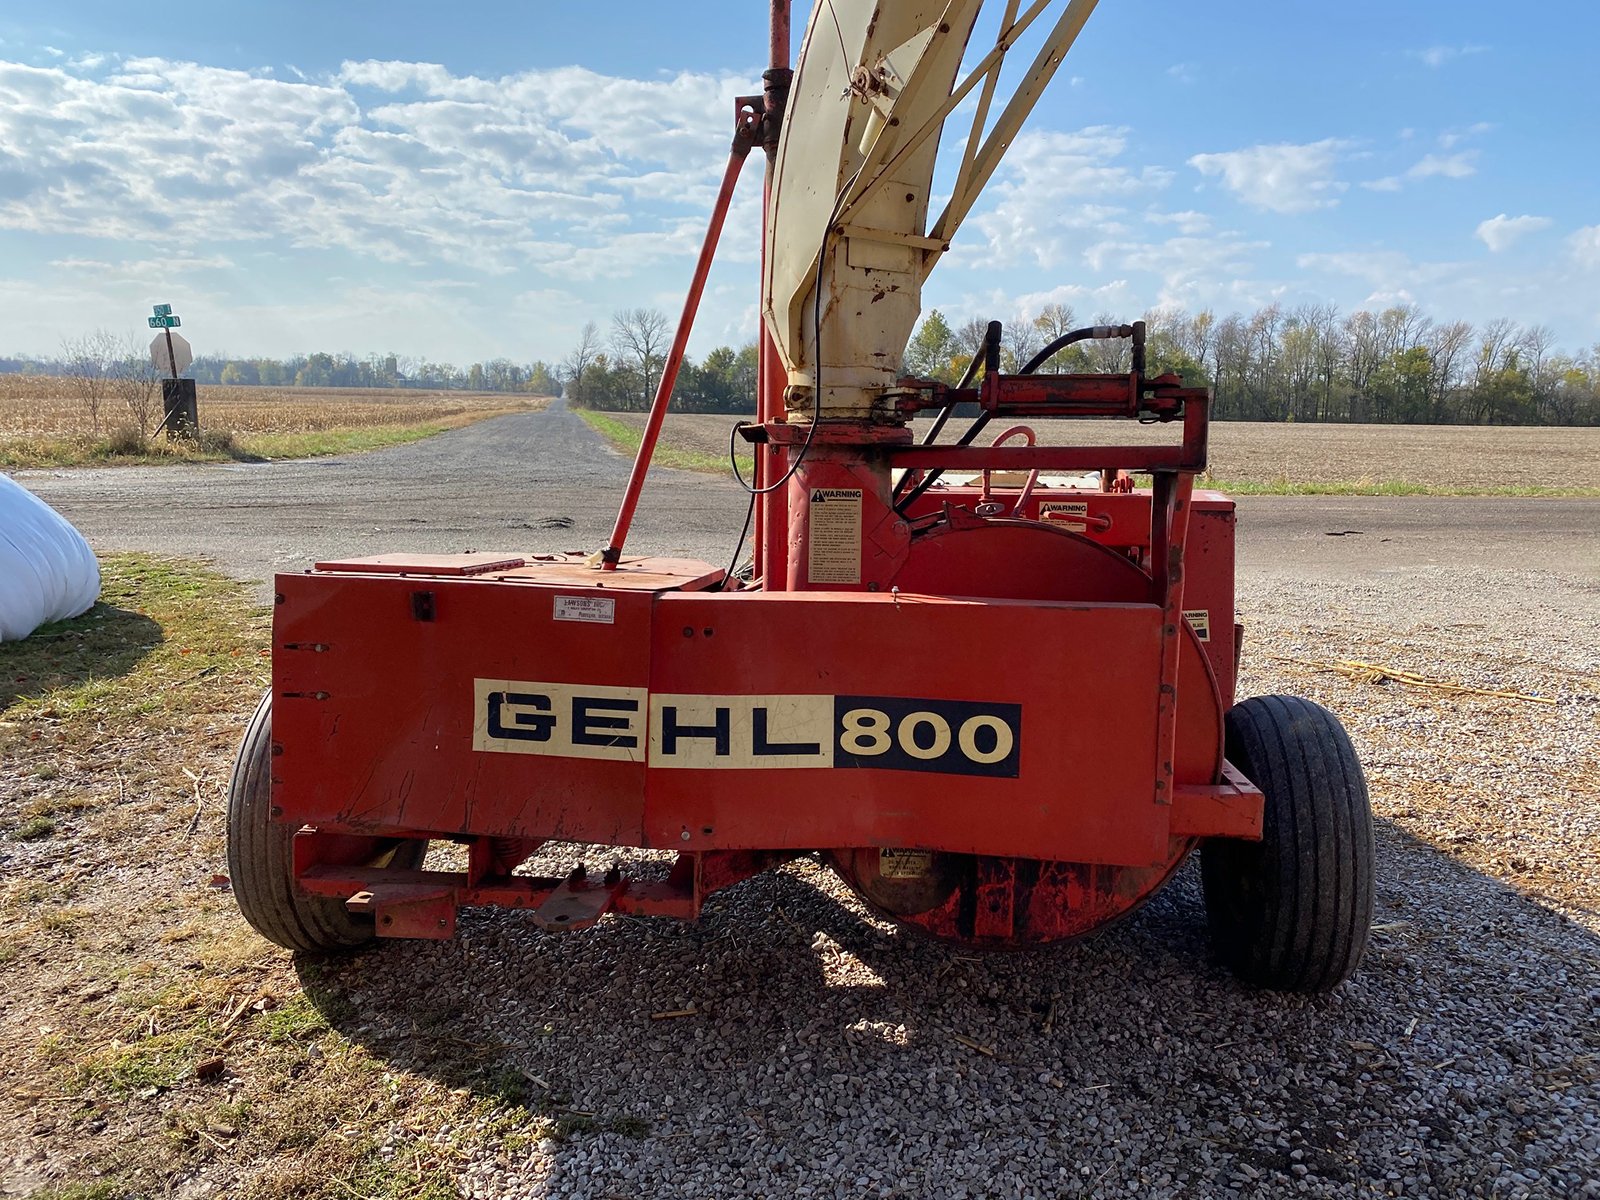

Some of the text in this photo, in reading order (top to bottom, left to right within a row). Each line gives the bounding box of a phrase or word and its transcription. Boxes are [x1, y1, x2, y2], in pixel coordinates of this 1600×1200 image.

[150, 317, 180, 327] 660 N
[822, 490, 861, 498] WARNING
[1050, 504, 1087, 512] WARNING
[487, 691, 1014, 764] GEHL 800
